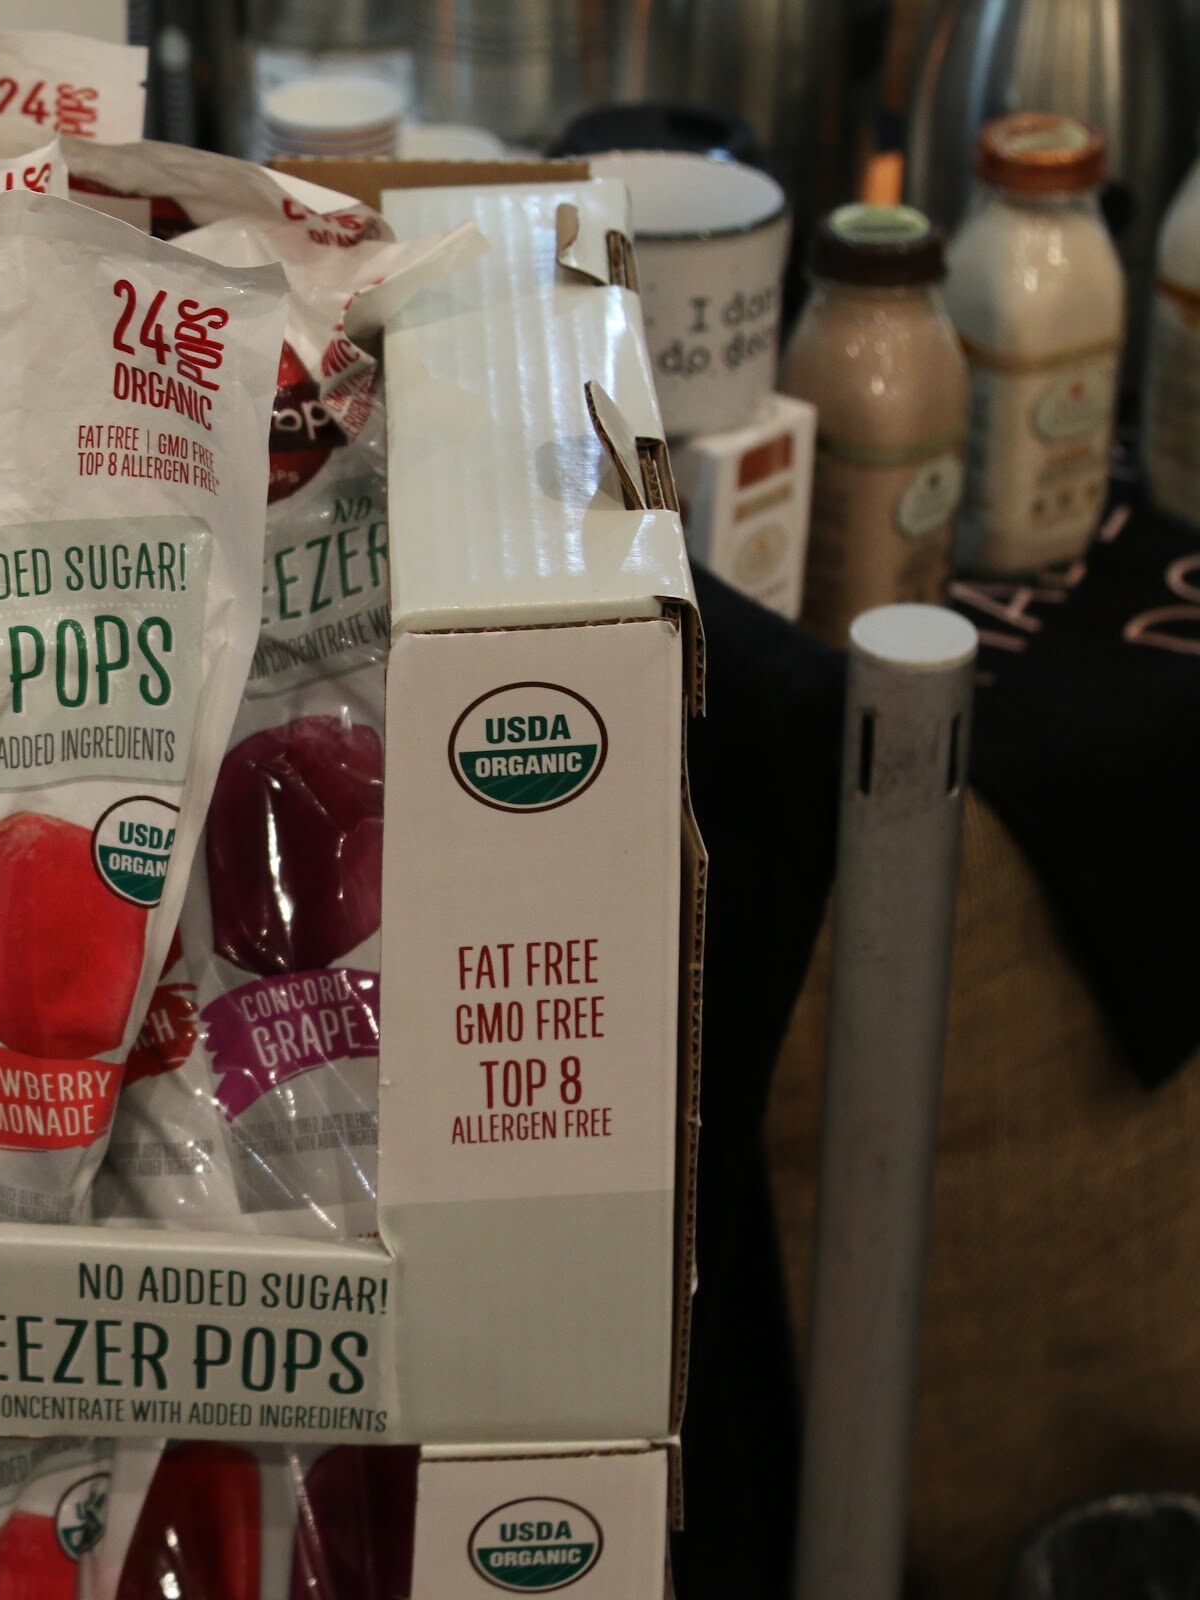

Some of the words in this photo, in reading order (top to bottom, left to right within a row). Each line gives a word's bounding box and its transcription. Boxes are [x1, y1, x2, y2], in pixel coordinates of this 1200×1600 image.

[113, 279, 171, 365] 24
[175, 299, 229, 391] POPS
[113, 362, 213, 431] ORGANIC
[78, 425, 104, 450] FAT
[108, 427, 140, 452] FREE
[158, 433, 188, 460] GMO
[193, 443, 214, 470] FREE
[78, 452, 105, 477] TOP
[108, 456, 118, 477] 8
[121, 455, 189, 485] ALLERGEN
[65, 542, 187, 592] SUGAR!
[9, 614, 173, 713] POPS
[61, 725, 176, 763] INGREDIENTS
[485, 714, 571, 744] USDA
[475, 752, 583, 779] ORGANIC
[108, 852, 168, 877] ORGAN
[458, 943, 515, 990] FAT
[526, 939, 598, 986] FREE
[240, 973, 351, 1023] CONCORD
[456, 1001, 523, 1045] GMO
[536, 996, 604, 1041] FREE
[252, 1005, 361, 1068] GRAPE
[479, 1058, 547, 1109] TOP
[560, 1055, 582, 1105] 8
[452, 1110, 557, 1145] ALLERGEN
[564, 1107, 612, 1138] FREE
[78, 1262, 124, 1301] NO
[138, 1266, 247, 1307] ADDED
[261, 1273, 388, 1315] SUGAR!
[194, 1324, 369, 1395] POPS
[131, 1399, 182, 1424] WITH
[188, 1402, 252, 1428] ADDED
[260, 1404, 388, 1432] INGREDIENTS
[500, 1521, 573, 1542] USDA
[489, 1548, 582, 1568] ORGANIC
